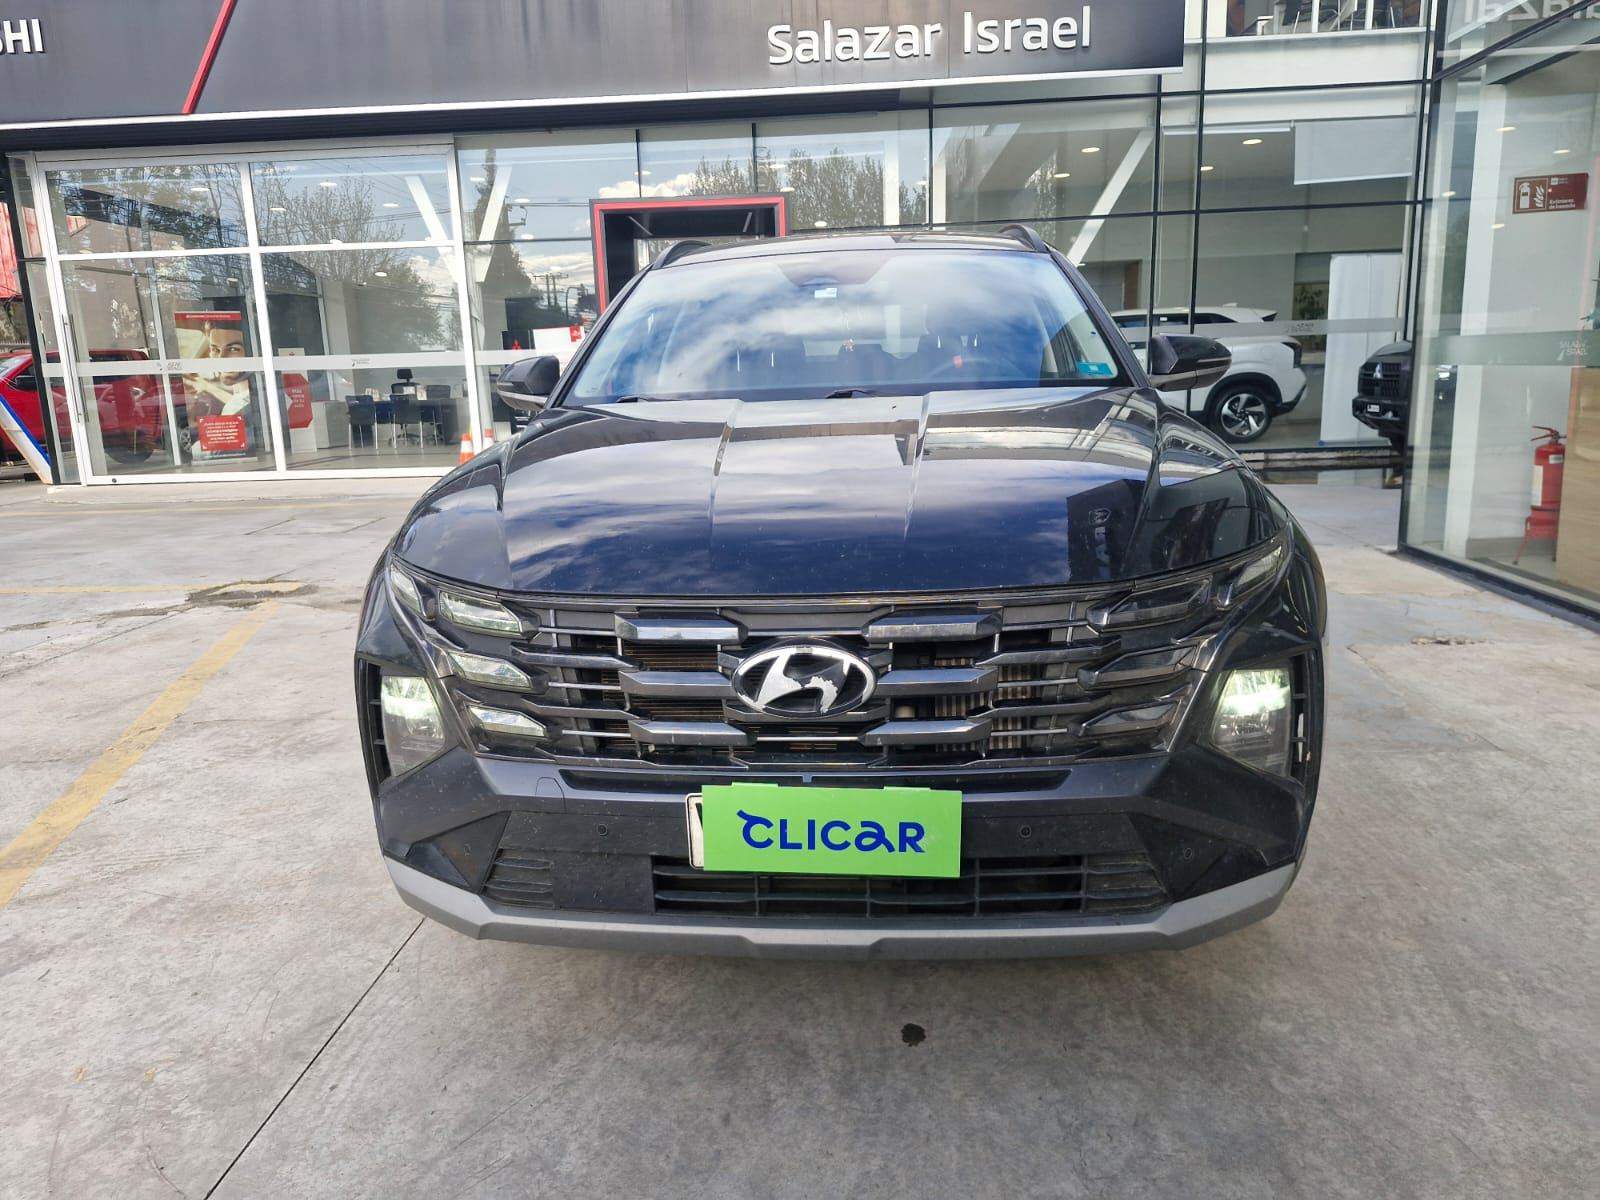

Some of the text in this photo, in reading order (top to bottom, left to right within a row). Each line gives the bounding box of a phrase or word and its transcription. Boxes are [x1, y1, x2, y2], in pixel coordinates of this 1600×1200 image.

[0, 18, 44, 54] HI
[767, 5, 1091, 64] Salazar Israel
